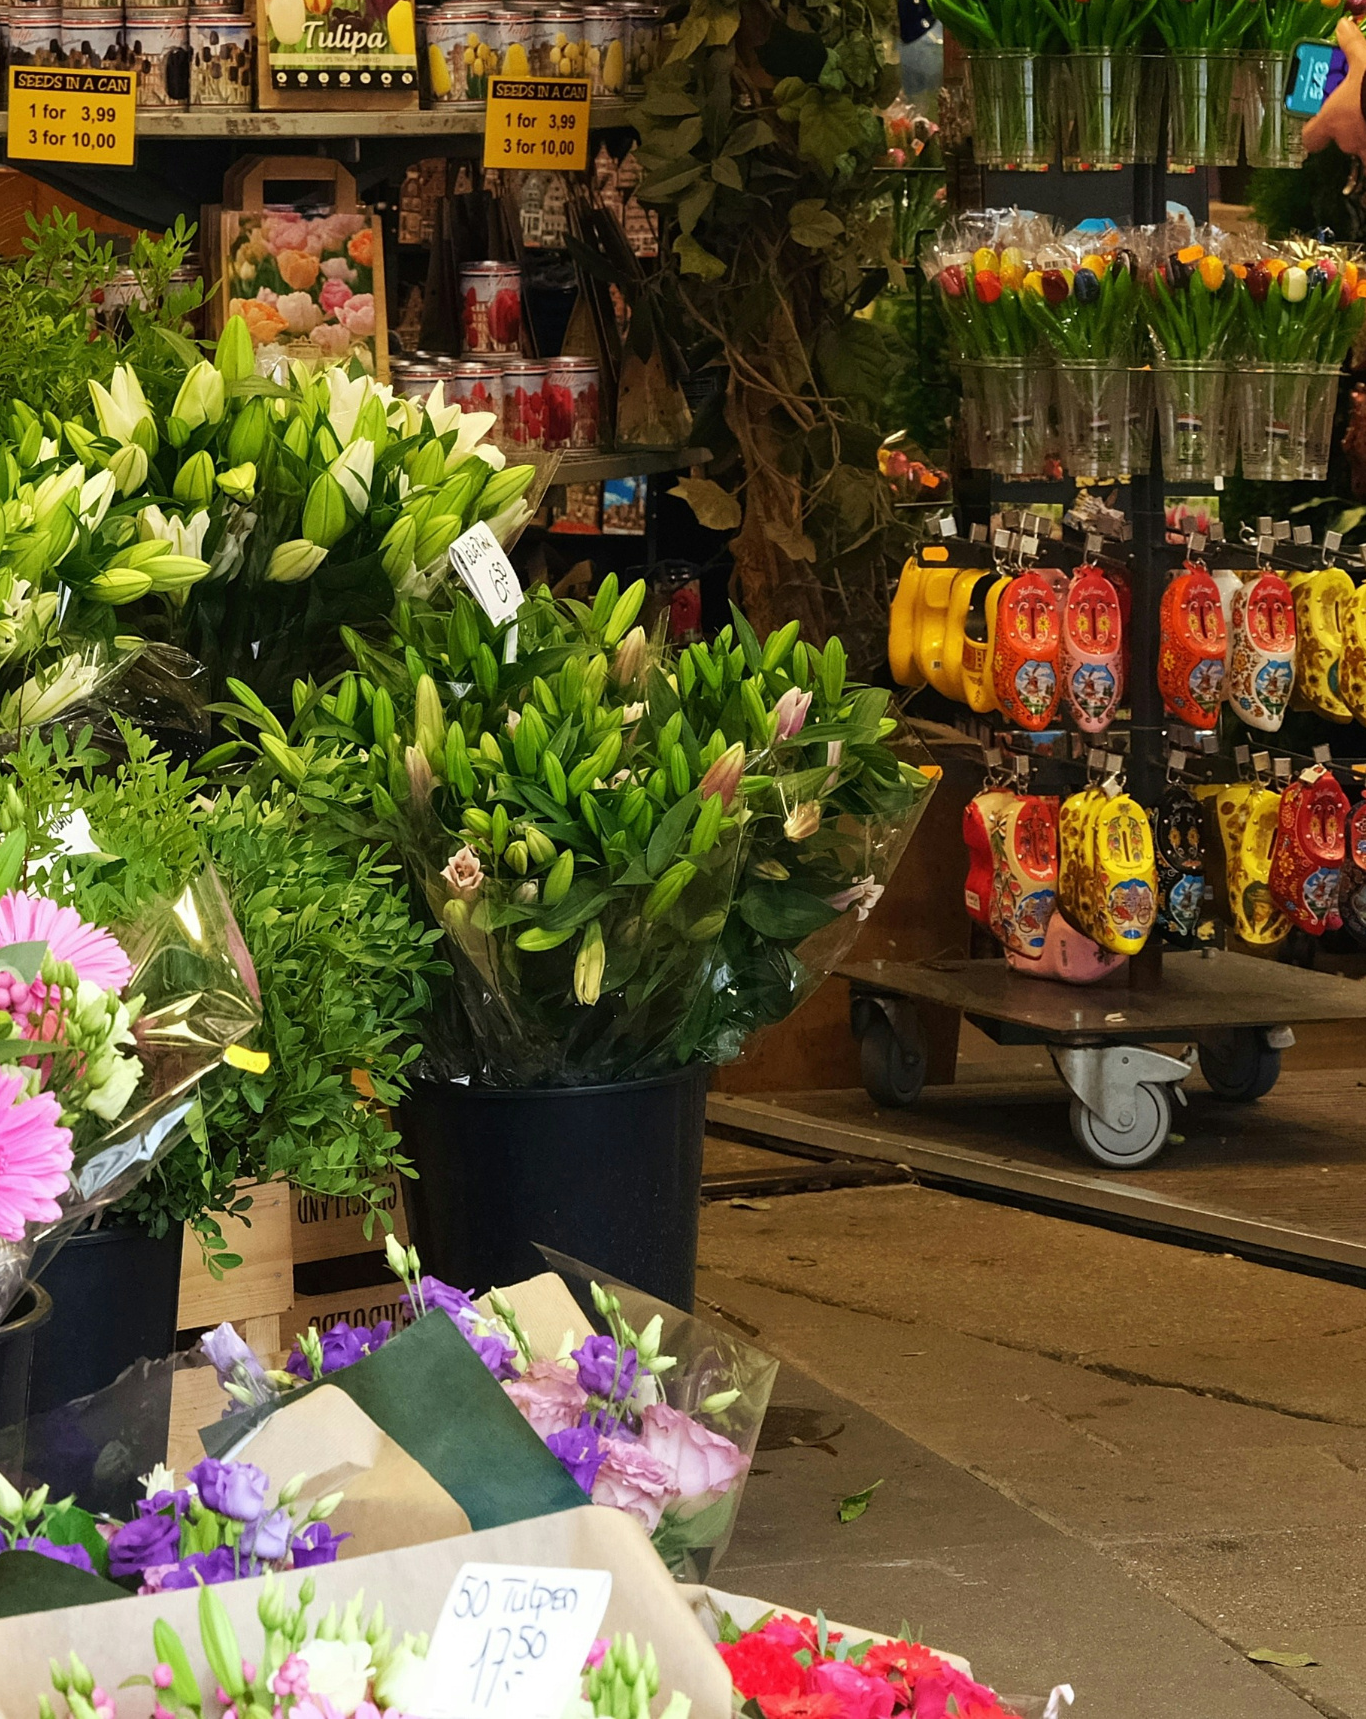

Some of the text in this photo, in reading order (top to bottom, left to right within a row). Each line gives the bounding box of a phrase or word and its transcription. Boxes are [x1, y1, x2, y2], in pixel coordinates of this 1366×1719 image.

[301, 20, 388, 55] Tulipa
[18, 73, 128, 92] SEEDS IN A CAN
[496, 83, 586, 98] SEEDS IN A CAN
[29, 103, 116, 124] 1 for 3,99
[505, 113, 576, 131] 1 for 3,99
[28, 129, 116, 150] 3 for 10,00
[503, 138, 575, 157] 3 for 10,00
[454, 1575, 490, 1618] 50
